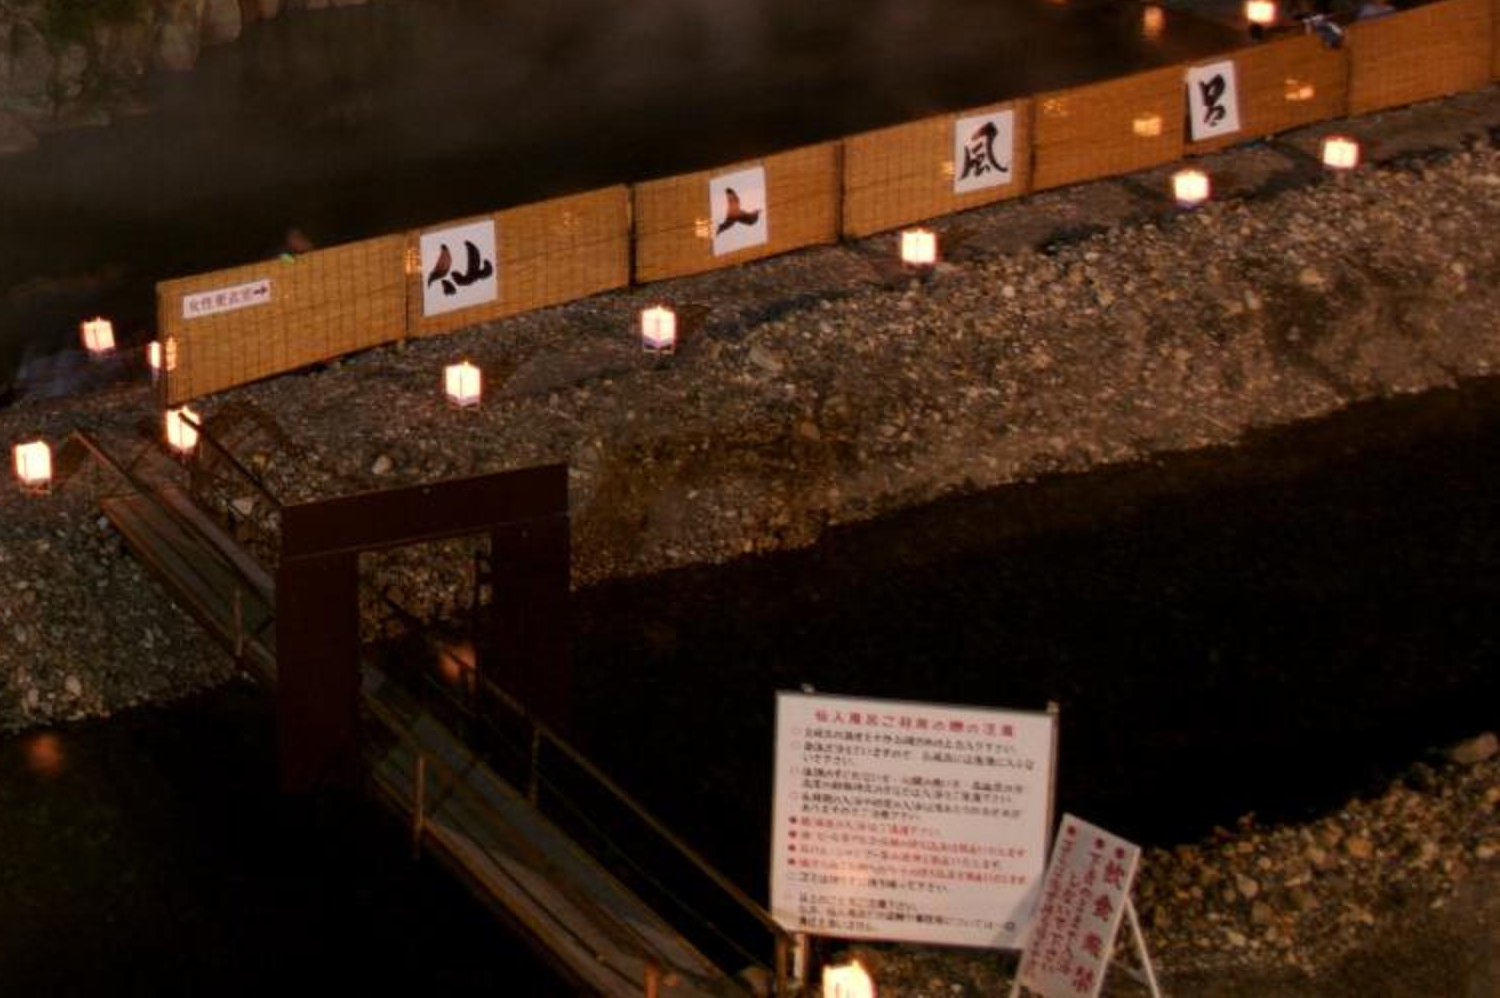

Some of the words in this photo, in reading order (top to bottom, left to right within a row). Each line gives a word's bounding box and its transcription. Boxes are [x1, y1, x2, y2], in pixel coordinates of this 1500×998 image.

[427, 240, 493, 296] 仙
[716, 187, 761, 235] 人
[959, 122, 1008, 180] 風
[1199, 74, 1226, 127] 呂
